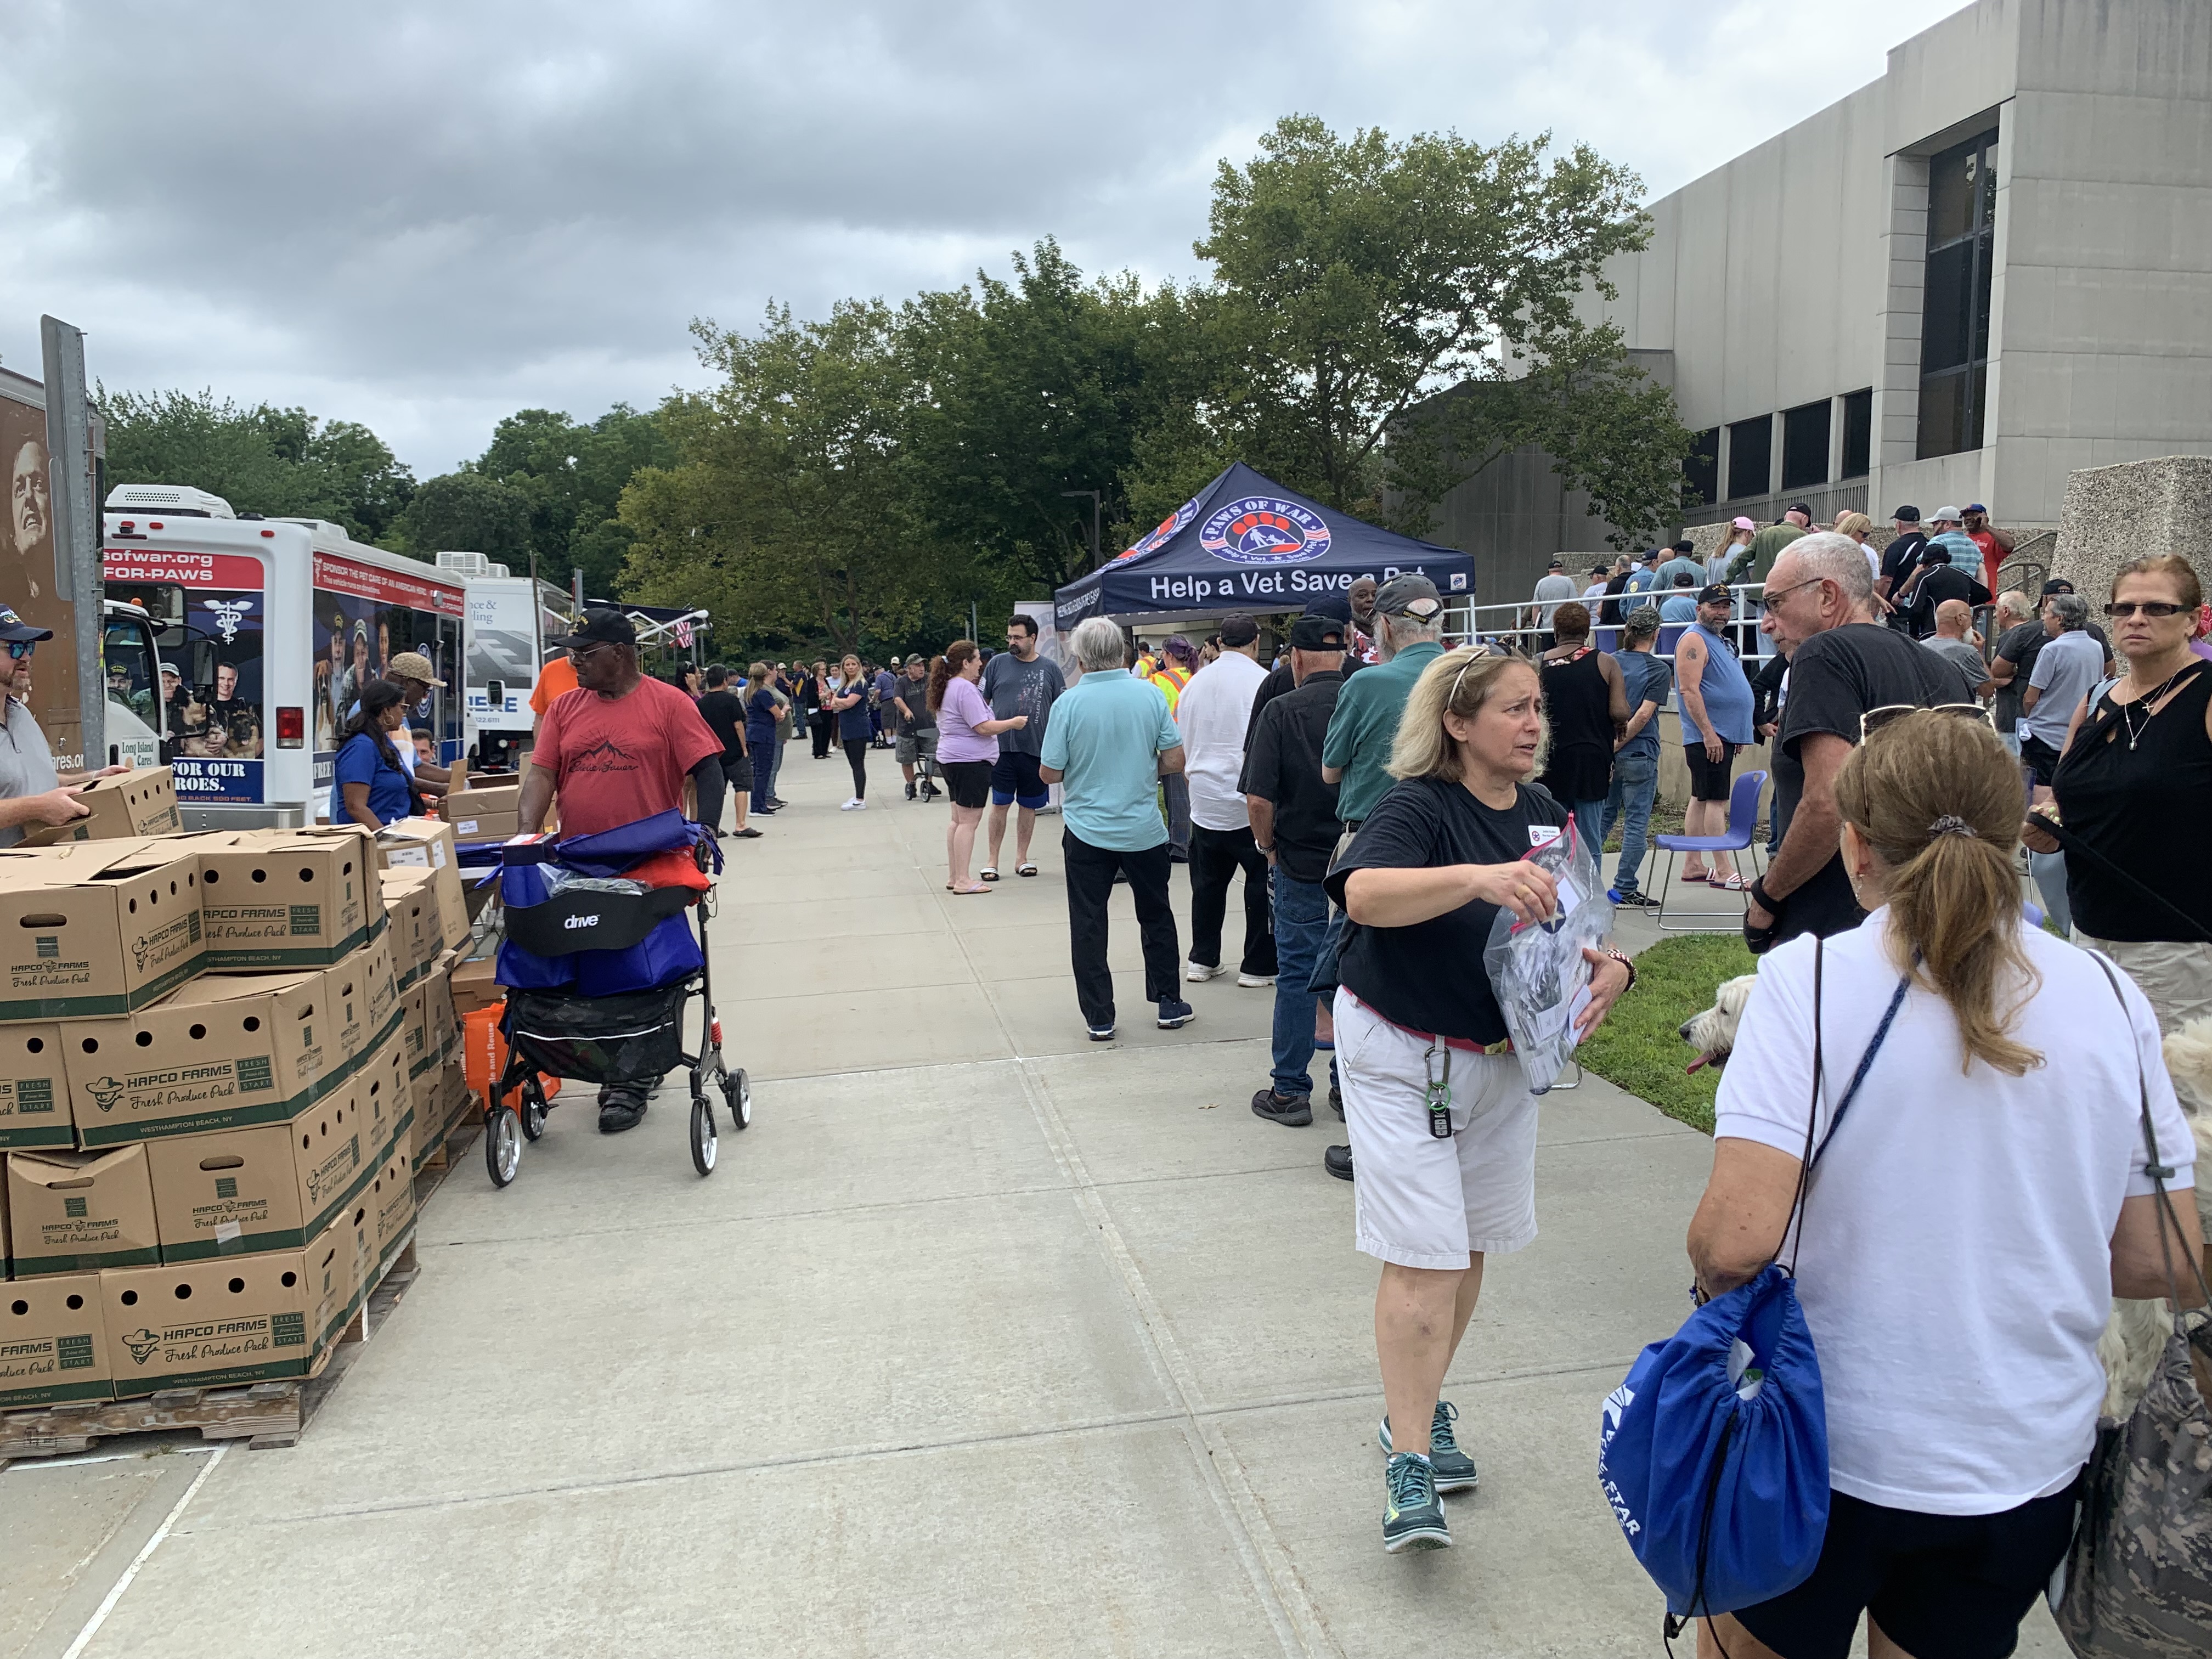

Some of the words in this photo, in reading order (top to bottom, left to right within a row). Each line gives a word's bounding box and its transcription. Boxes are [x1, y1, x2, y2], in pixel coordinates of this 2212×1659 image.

[1205, 505, 1242, 535] PAWS
[1244, 500, 1268, 510] OF
[1275, 503, 1312, 524] WAR
[1222, 548, 1240, 558] Help
[1307, 541, 1318, 550] Pet
[323, 562, 348, 575] SPONSOR
[349, 568, 359, 579] THE
[369, 574, 382, 584] CARE
[323, 574, 333, 584] This
[1151, 575, 1211, 602] Help
[1218, 579, 1234, 595] a
[1240, 571, 1285, 594] Vet
[1290, 569, 1353, 592] Save
[486, 600, 496, 610] &
[122, 742, 136, 755] Long
[138, 741, 154, 753] Island
[137, 754, 152, 766] Cares
[171, 762, 202, 776] FOR
[208, 763, 246, 777] OUR
[313, 761, 332, 780] FREE
[241, 908, 286, 918] FARMS
[564, 914, 599, 929] drive
[149, 928, 170, 946] HAPCO
[225, 924, 262, 938] Produce
[264, 924, 287, 937] Pack
[11, 964, 43, 972] HAPCO
[58, 961, 89, 969] FARMS
[12, 975, 37, 988] Fresh
[40, 975, 70, 985] Produce
[71, 973, 91, 984] Pack
[239, 1058, 268, 1068] FRESH
[127, 1073, 178, 1088] HAPCO
[182, 1064, 232, 1080] FARMS
[242, 1079, 270, 1090] START
[130, 1092, 163, 1109] Fresh
[167, 1088, 207, 1104] Produce
[210, 1081, 235, 1098] Pack
[140, 1121, 194, 1133] WESTHAMPTON
[193, 1205, 222, 1214] HAPCO
[237, 1199, 267, 1209] FARMS
[87, 1218, 119, 1228] FARMS
[194, 1215, 218, 1228] Fresh
[250, 1210, 268, 1221] Pack
[44, 1234, 67, 1245] Fresh
[70, 1233, 99, 1243] Produce
[101, 1229, 119, 1241] Pack
[163, 1325, 214, 1341] HAPCO
[217, 1319, 267, 1334] FARMS
[1, 1342, 52, 1357] FARMS
[60, 1338, 89, 1346] FRESH
[165, 1345, 198, 1363] Fresh
[201, 1344, 241, 1358] Produce
[244, 1336, 269, 1353] Pack
[29, 1359, 54, 1375] Pack
[172, 1373, 227, 1385] WESTHAMPTON
[1607, 1481, 1641, 1536] STAR
